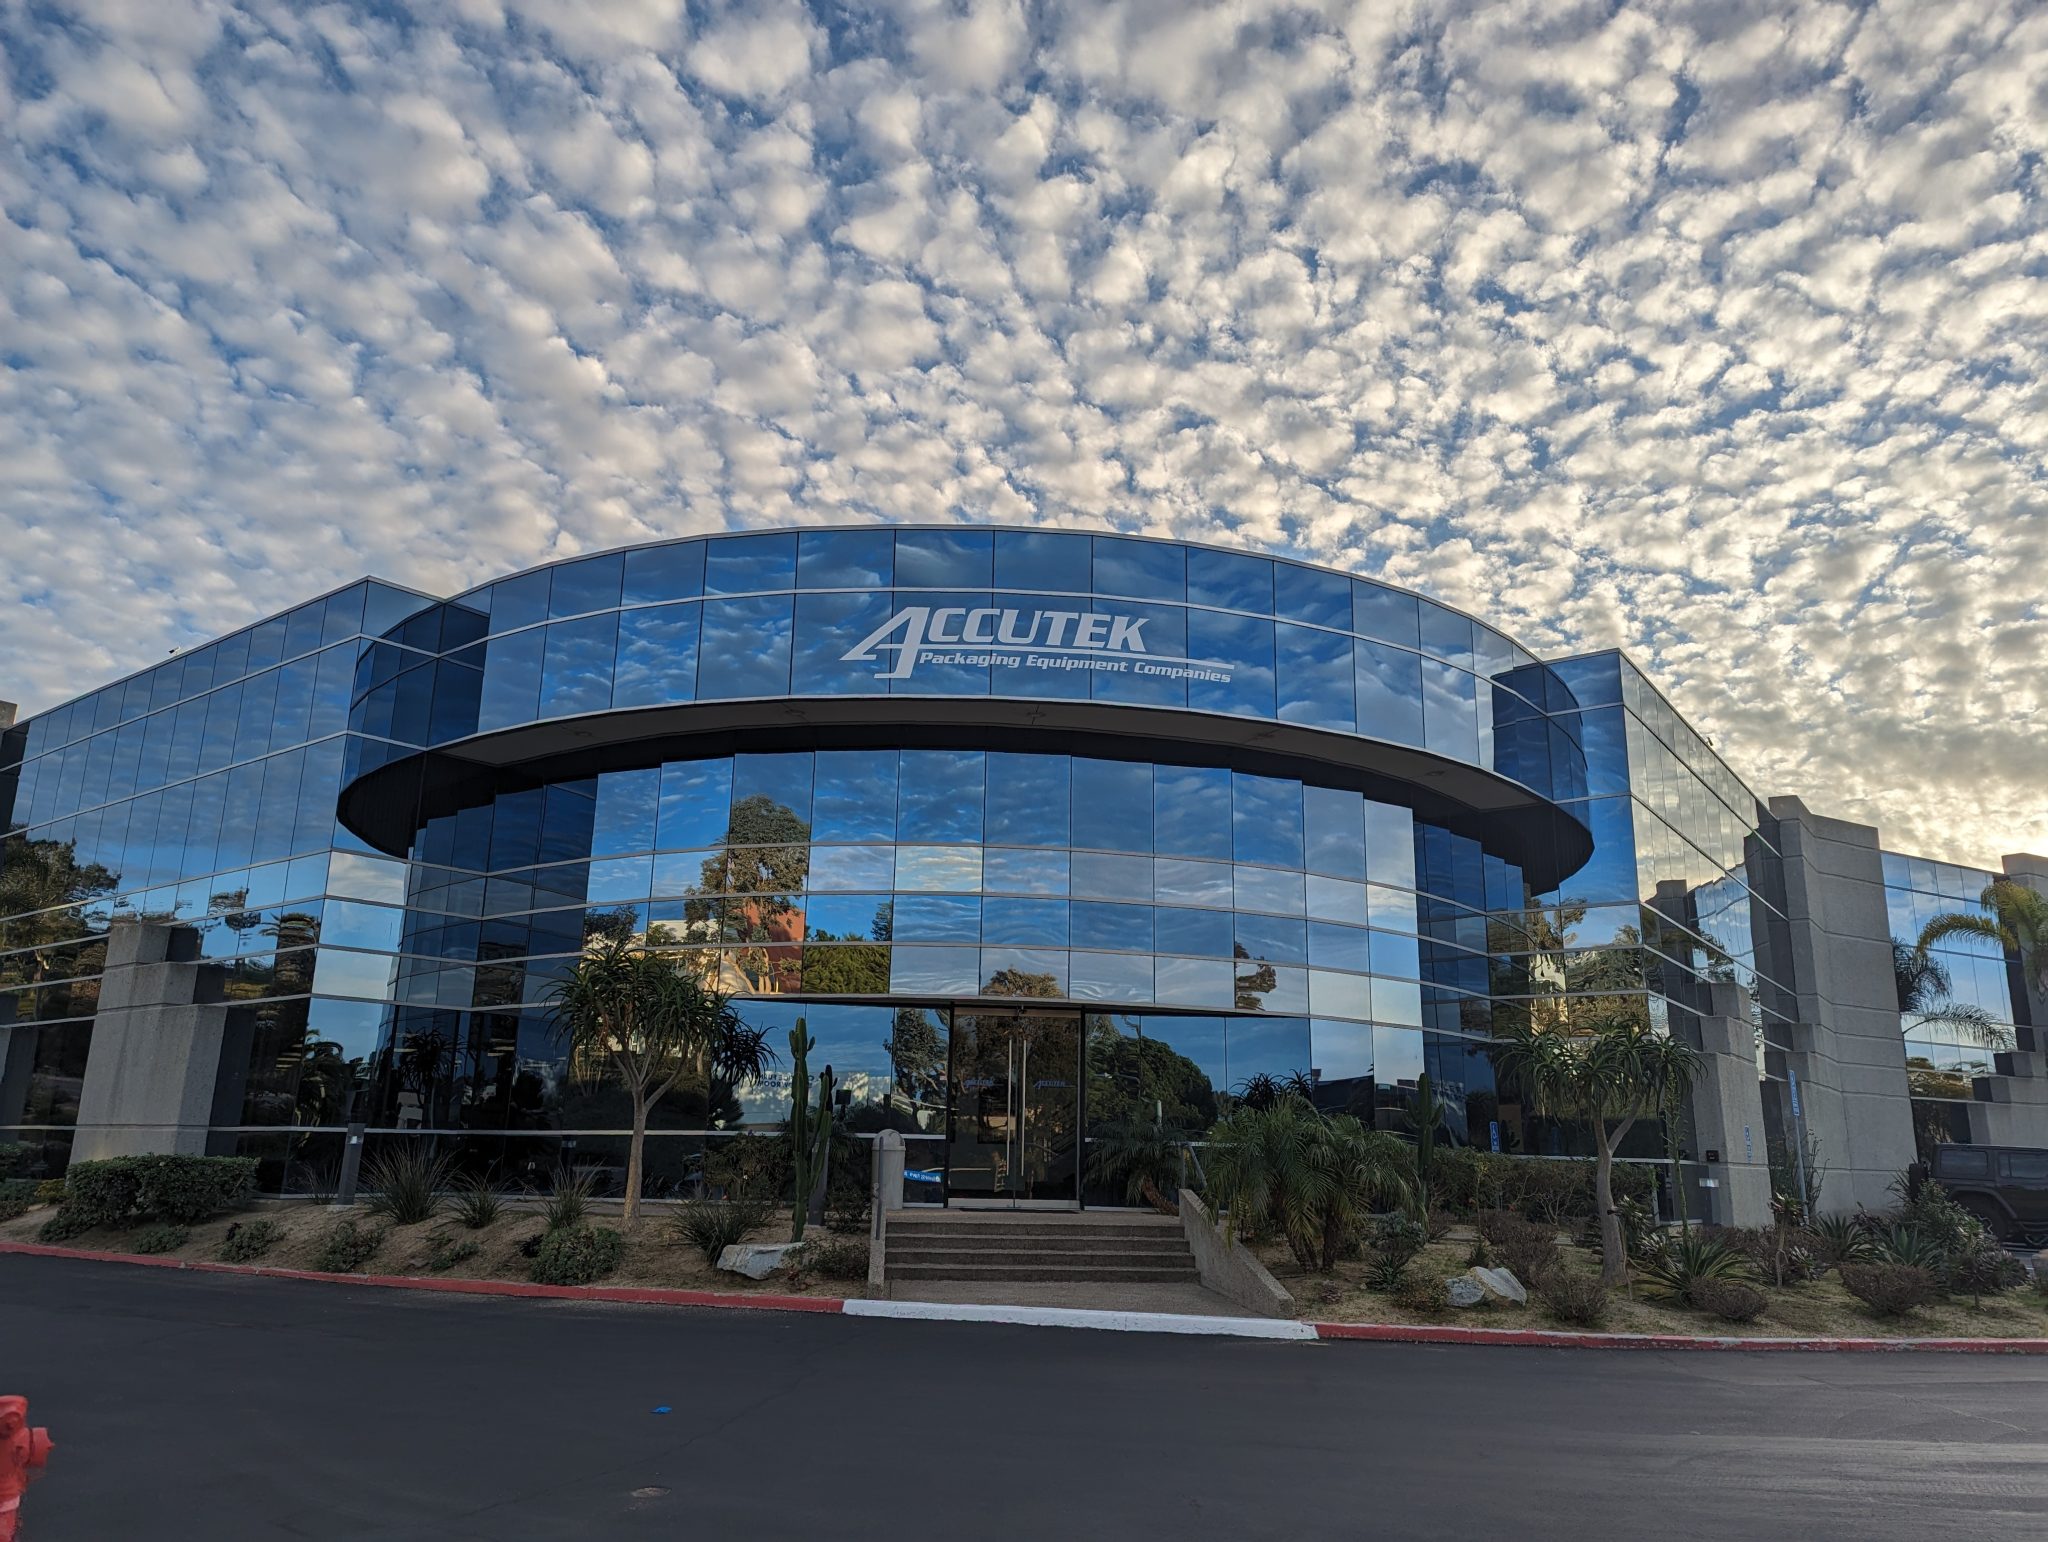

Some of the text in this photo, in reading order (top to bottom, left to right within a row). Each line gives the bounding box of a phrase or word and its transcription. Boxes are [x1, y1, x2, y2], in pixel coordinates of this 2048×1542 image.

[839, 606, 1150, 679] ACCUTEK
[919, 652, 1231, 683] Packaging Equipment Companies
